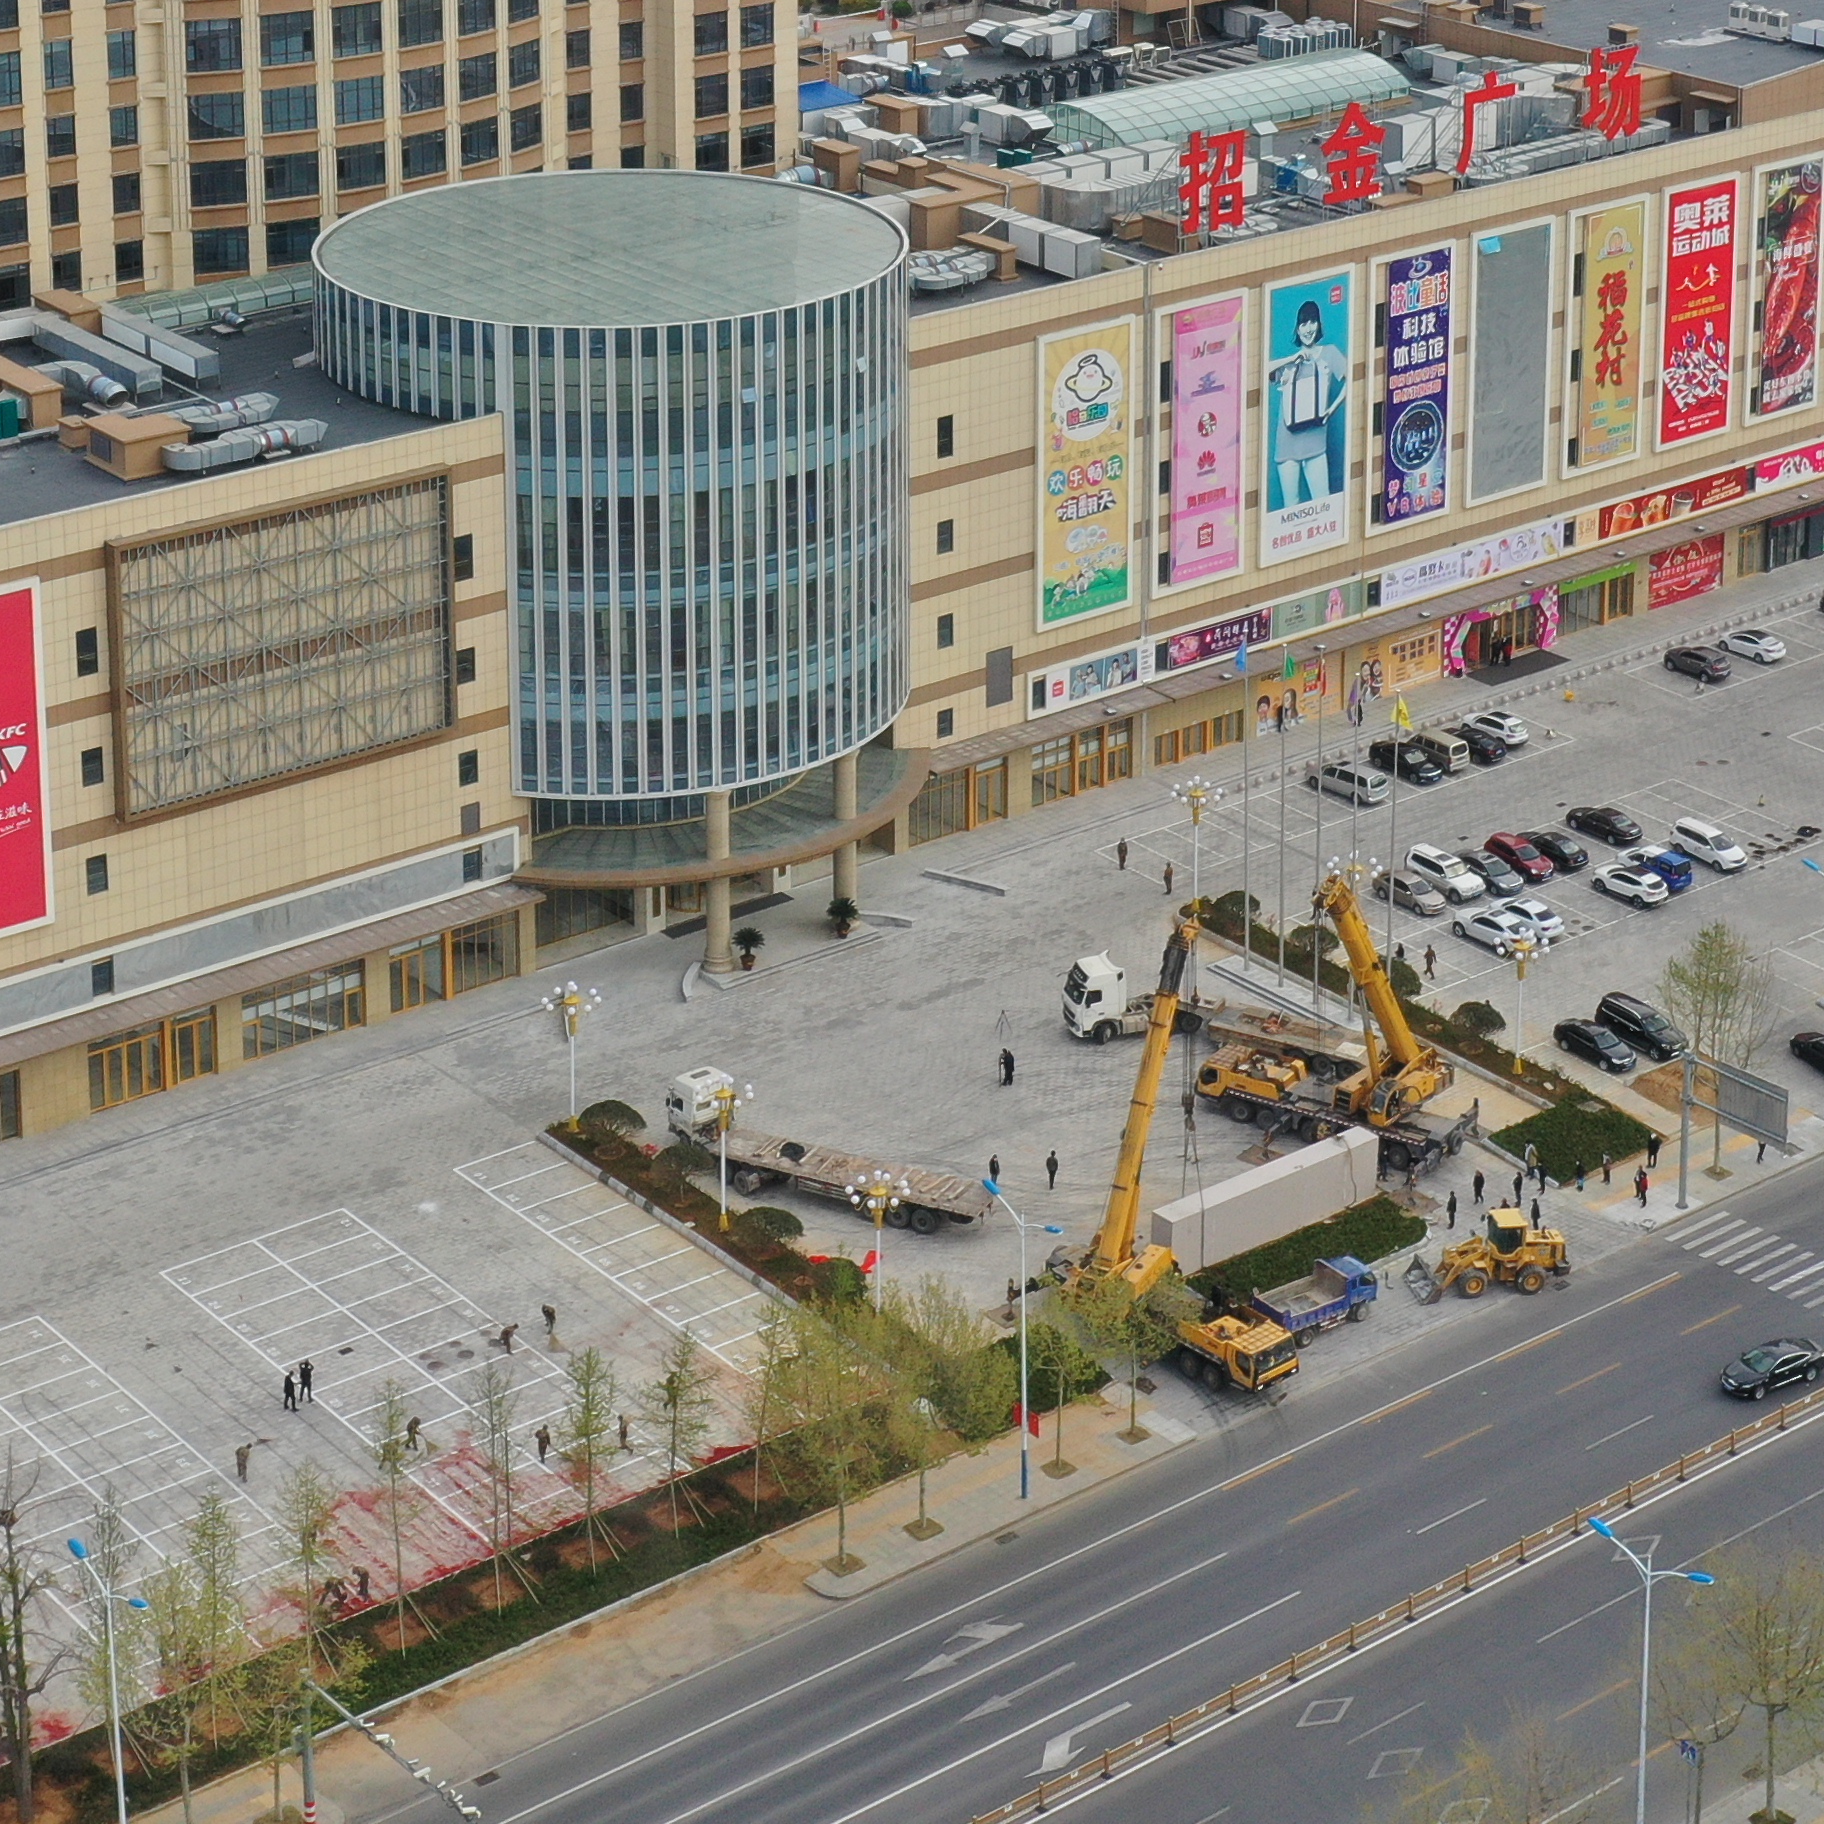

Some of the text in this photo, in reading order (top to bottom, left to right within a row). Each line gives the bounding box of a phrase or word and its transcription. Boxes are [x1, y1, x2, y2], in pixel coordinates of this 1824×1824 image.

[1178, 44, 1642, 234] 招金广场
[1673, 193, 1731, 234] 奥莱
[1671, 224, 1731, 258] 运动城
[1390, 269, 1449, 318] 波比童话
[1402, 311, 1438, 340] 科技
[1393, 336, 1445, 369] 体验馆
[1048, 457, 1123, 494] 欢乐畅玩
[1056, 489, 1117, 522] 嗨翻天
[1281, 506, 1315, 525] MINISO
